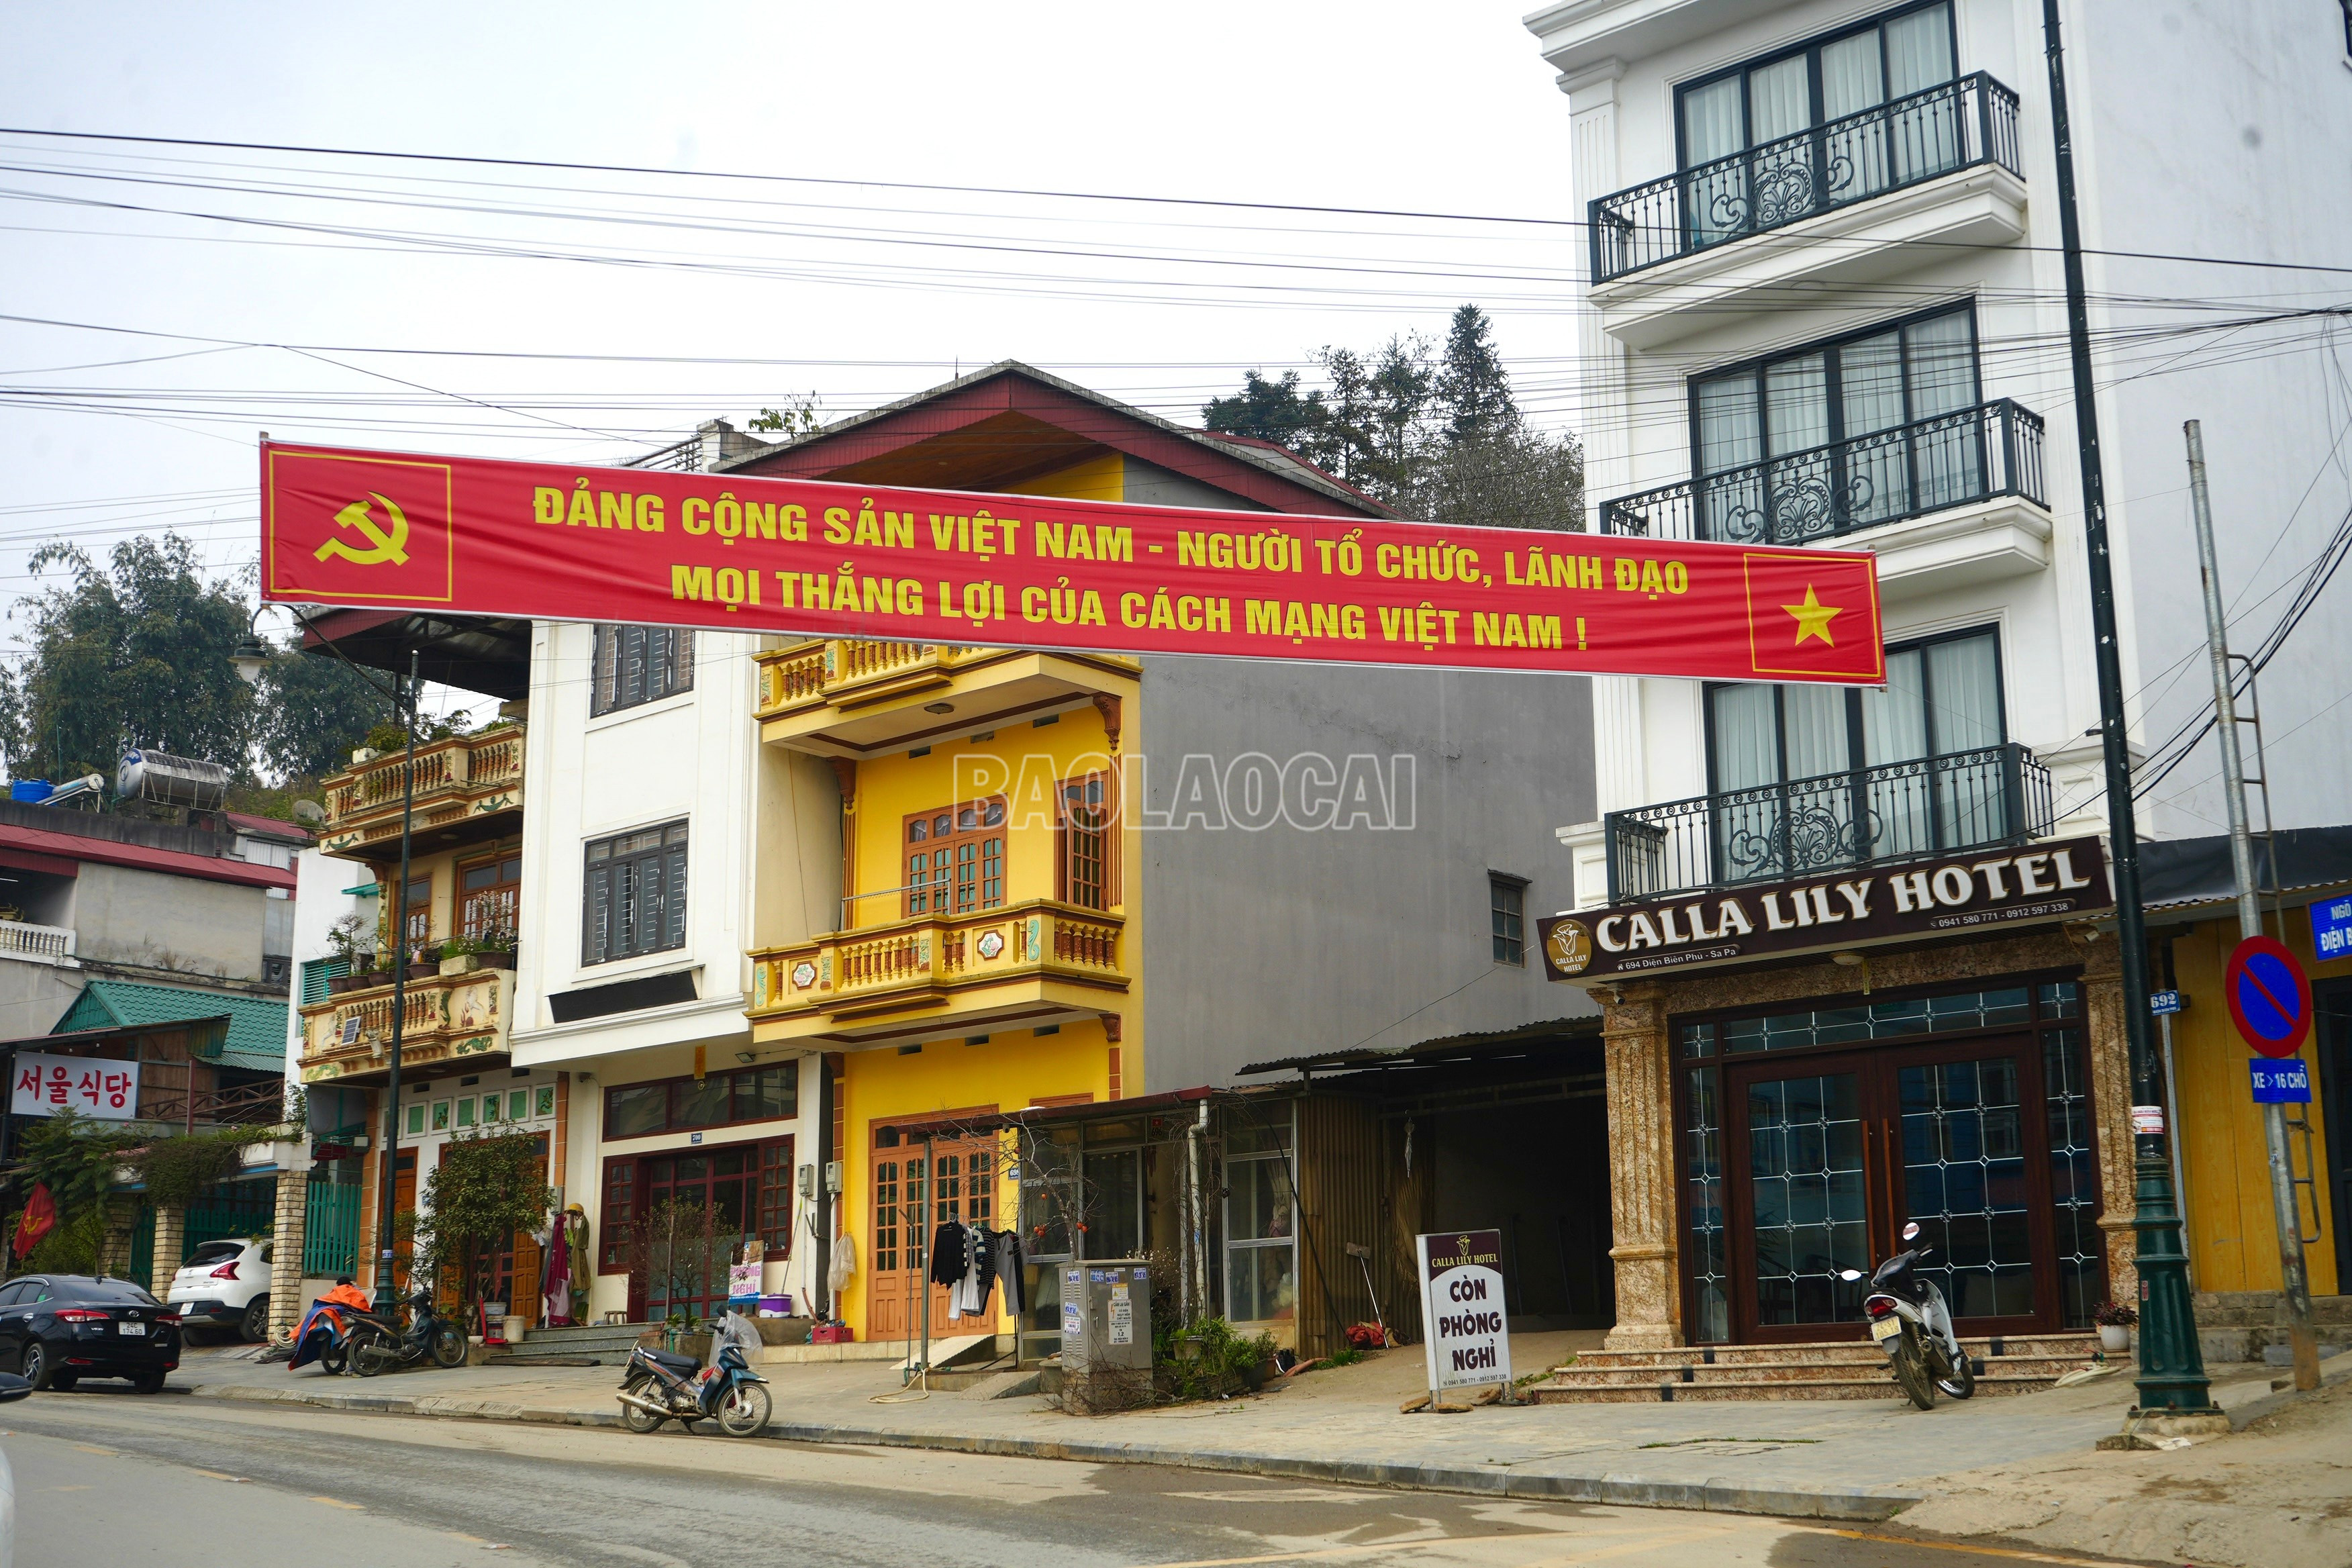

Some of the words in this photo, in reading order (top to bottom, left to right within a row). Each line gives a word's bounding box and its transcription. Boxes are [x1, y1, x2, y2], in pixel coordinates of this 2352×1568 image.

[532, 477, 665, 532] ĐẢNG
[682, 493, 807, 545] CỘNG
[824, 497, 914, 548] SẢN
[929, 510, 1021, 562] VIỆT
[1036, 522, 1133, 562] NAM
[1178, 528, 1302, 572] NGƯỜI
[1315, 528, 1363, 576] TỔ
[1376, 540, 1491, 588] CHỨC,
[1505, 546, 1603, 589] LÃNH
[1614, 558, 1688, 600] ĐẠO
[672, 565, 760, 612] MỌI
[776, 562, 924, 615] THẮNG
[939, 580, 1006, 628] LỢI
[1021, 577, 1108, 626] CỦA
[1120, 587, 1231, 633] CÁCH
[1245, 599, 1367, 644] MẠNG
[1378, 601, 1460, 651] VIỆT
[1473, 611, 1562, 650] NAM
[1596, 897, 1757, 953] CALLA
[1759, 877, 1876, 932] LILY
[1888, 848, 2092, 914] HOTEL
[1939, 918, 1961, 927] 0941
[1963, 915, 1979, 924] 580
[1981, 912, 1998, 922] 771
[2006, 908, 2029, 918] 0912
[2032, 905, 2048, 915] 597
[2051, 902, 2069, 912] 338
[2320, 926, 2345, 952] ĐIỆN
[1555, 956, 1574, 965] CALLA
[1575, 954, 1586, 962] LILY
[1563, 964, 1582, 972] HOTEL
[1625, 961, 1640, 969] 694
[1643, 957, 1663, 968] Điện
[1664, 955, 1683, 965] Biên
[1710, 950, 1722, 959] Sa
[1724, 948, 1736, 957] Pa
[2150, 993, 2177, 1008] 692
[2251, 1072, 2266, 1089] XE
[2275, 1073, 2287, 1089] 16
[2288, 1064, 2307, 1089] CHỖ
[1432, 1257, 1455, 1268] CALLA
[1456, 1255, 1472, 1265] LILY
[1473, 1253, 1498, 1265] HOTEL
[732, 1279, 756, 1295] NGHỈ
[1449, 1275, 1487, 1302] CÒN
[1439, 1309, 1502, 1338] PHÒNG
[1452, 1338, 1496, 1371] NGHỈ
